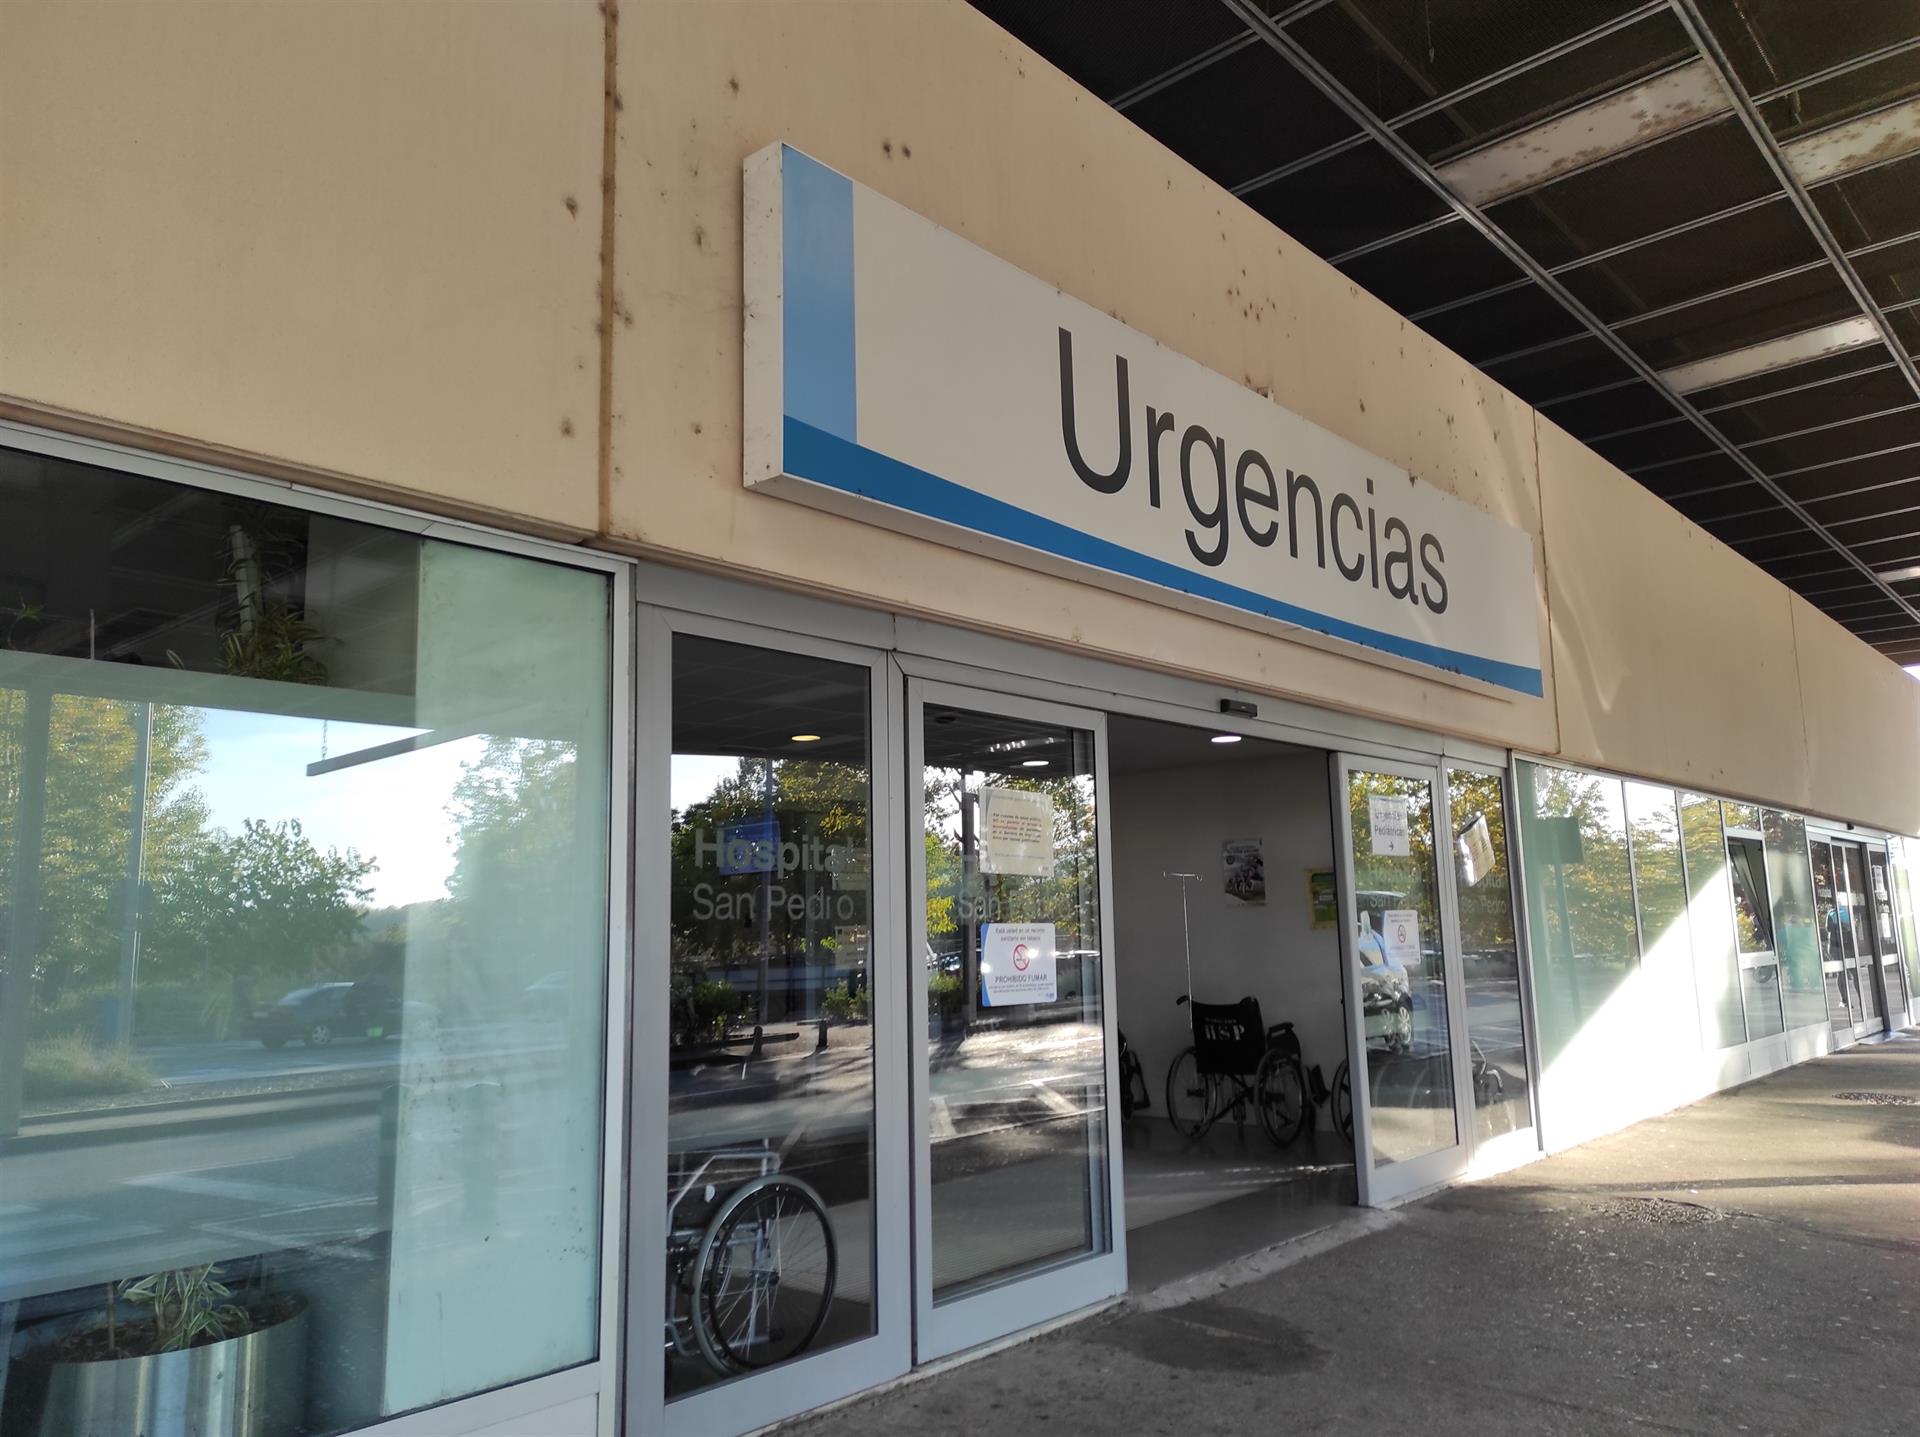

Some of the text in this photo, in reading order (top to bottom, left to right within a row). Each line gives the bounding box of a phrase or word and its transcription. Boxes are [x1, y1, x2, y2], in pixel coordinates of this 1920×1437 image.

[1058, 326, 1449, 615] Urgencias
[692, 882, 854, 921] San Pedro
[995, 973, 1048, 984] PROHIBIDO FUMAR
